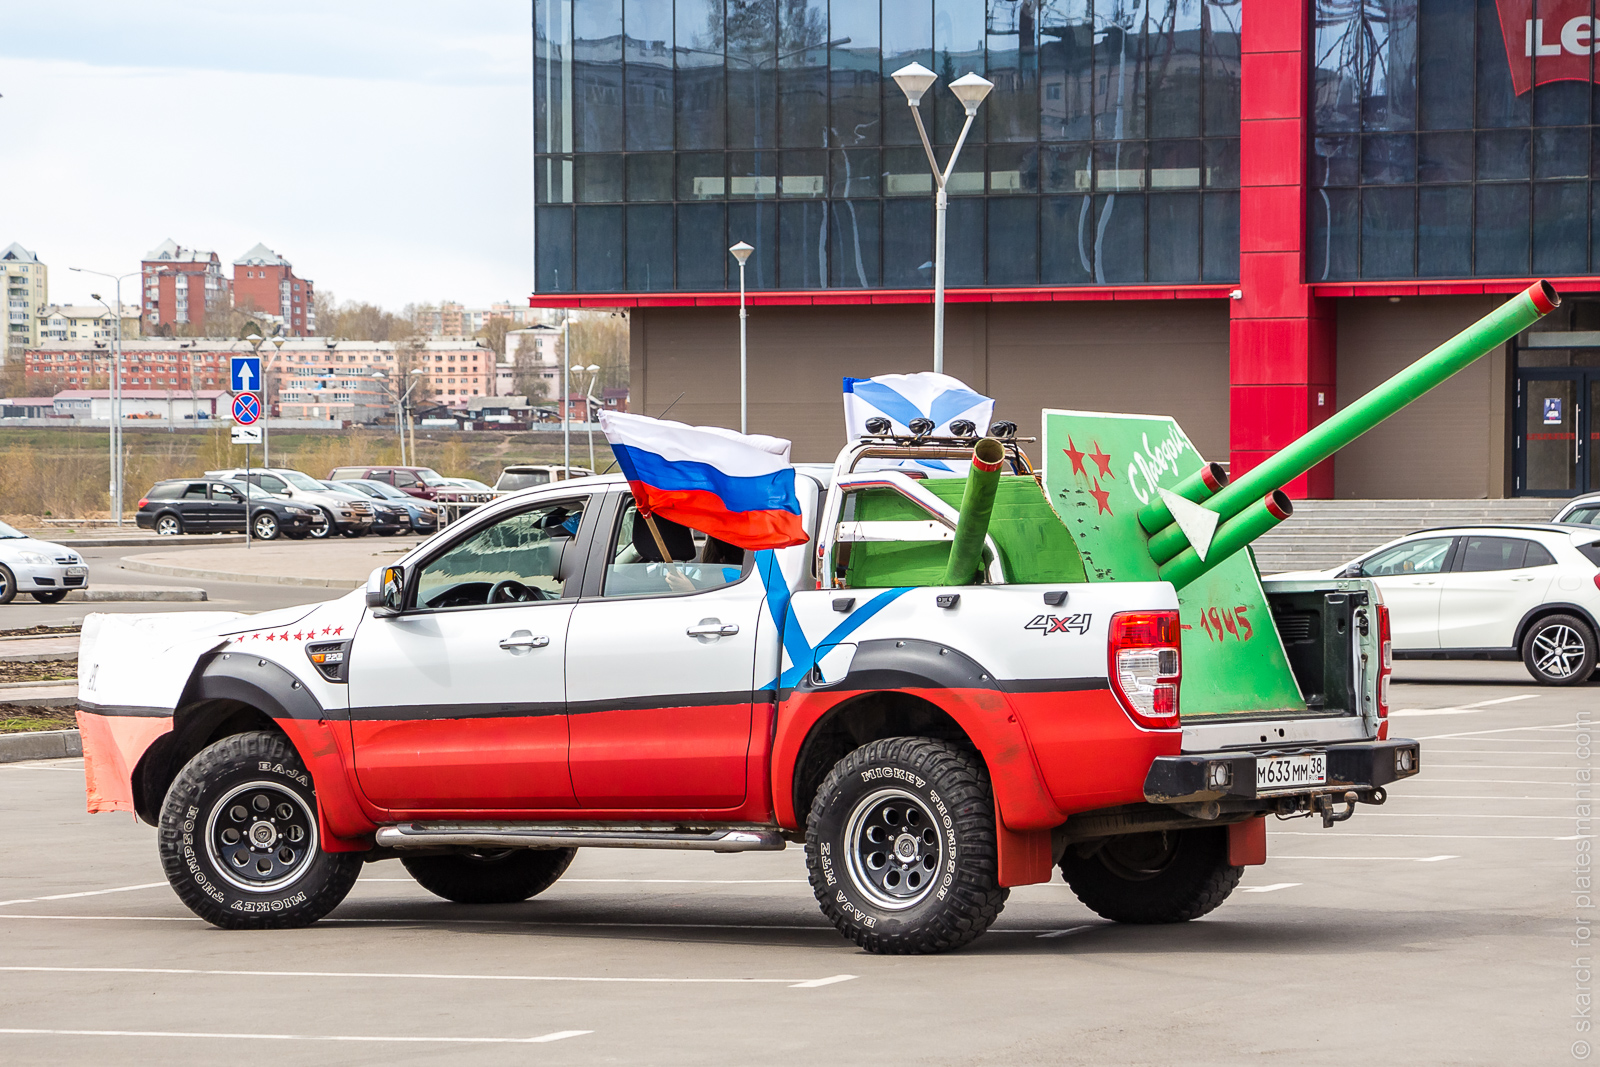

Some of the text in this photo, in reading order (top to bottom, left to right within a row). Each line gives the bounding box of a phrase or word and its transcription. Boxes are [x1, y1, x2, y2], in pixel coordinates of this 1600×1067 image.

[1200, 606, 1254, 643] 1945
[258, 761, 308, 787] BAJA
[182, 805, 307, 912] MICKEY THOMPSON
[861, 766, 957, 901] MICKEY THOMPSON
[820, 842, 877, 929] BAJA MTZ
